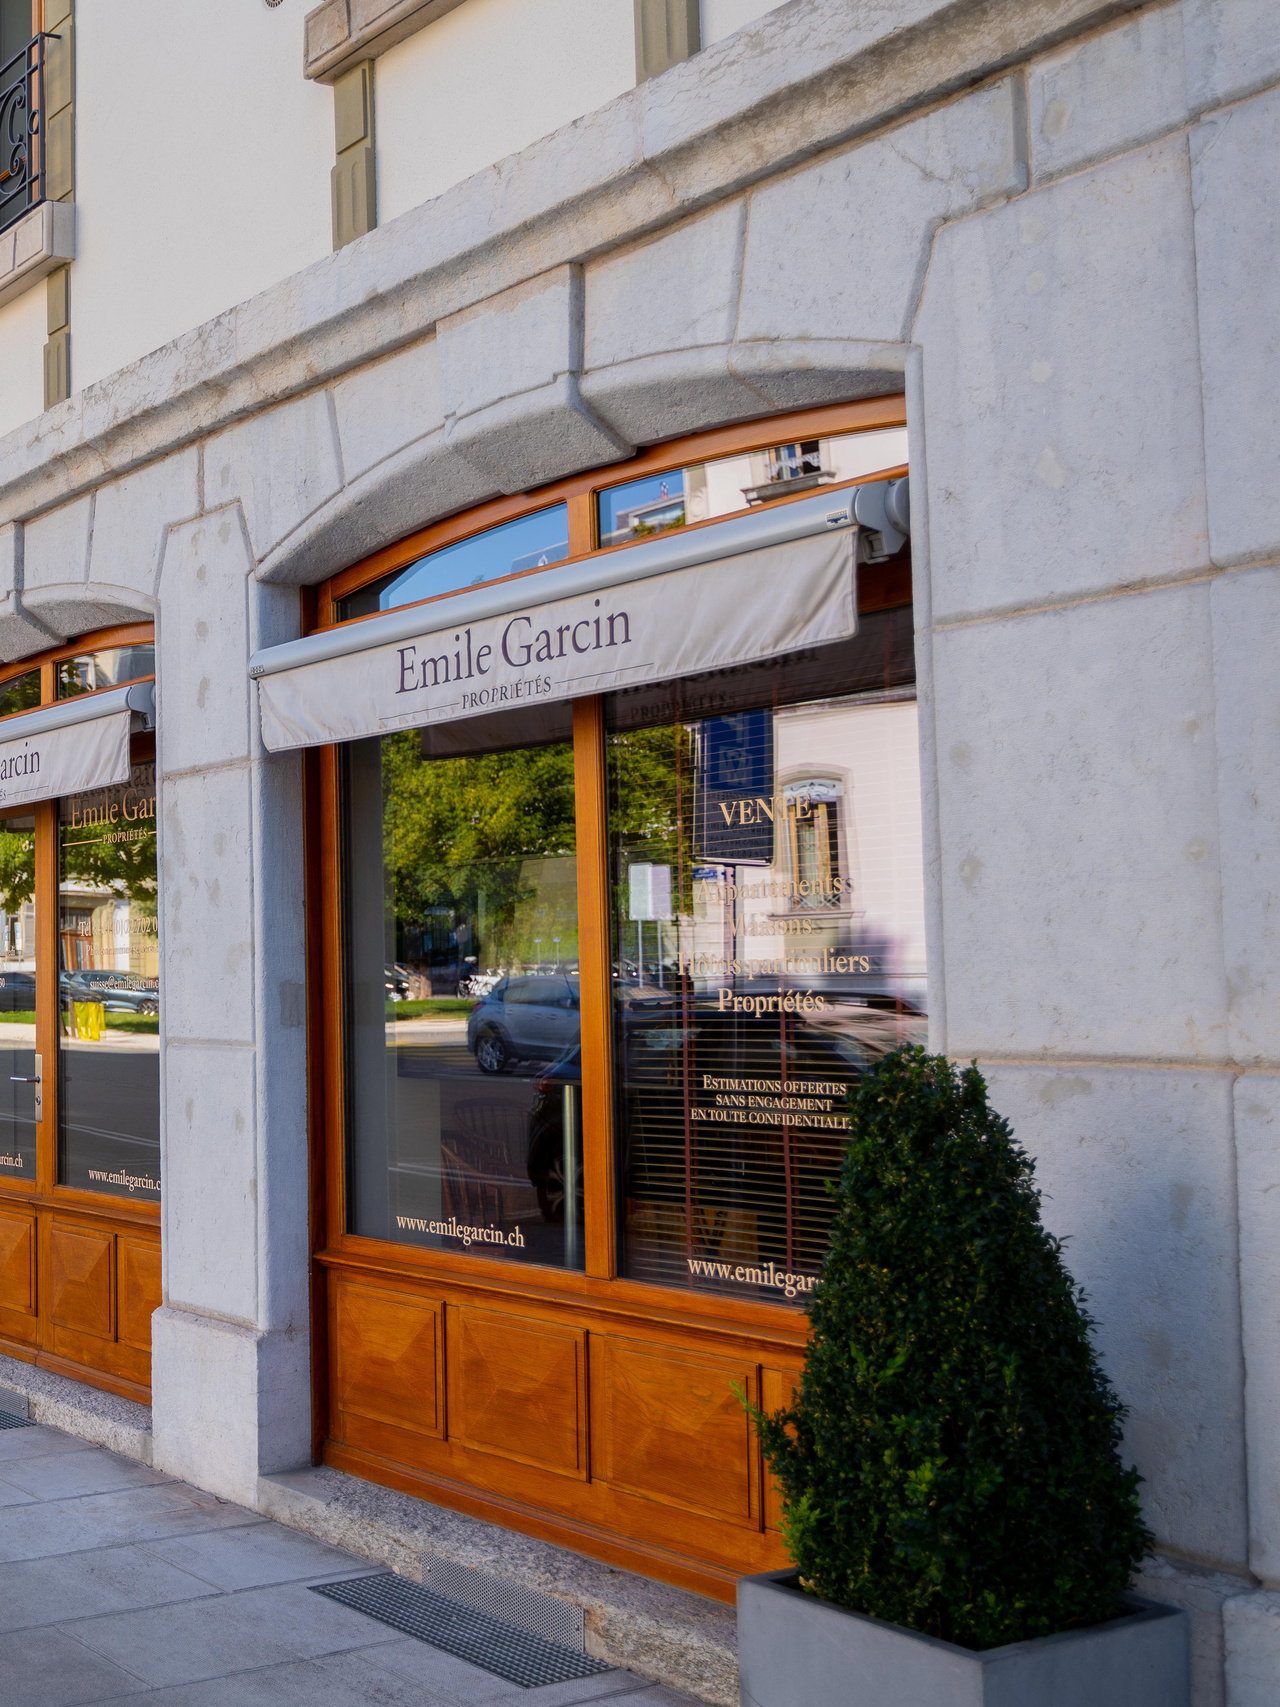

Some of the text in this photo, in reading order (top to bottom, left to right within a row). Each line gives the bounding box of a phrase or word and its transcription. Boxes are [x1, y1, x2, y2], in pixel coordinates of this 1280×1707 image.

[395, 598, 633, 695] Emile Garcin
[461, 674, 553, 711] PROPRIÉTÉS
[70, 788, 156, 830] Emile Gar
[719, 795, 812, 826] VENTE
[103, 827, 148, 845] PROPRIÉTÉS
[697, 875, 844, 906] Appartements
[726, 911, 813, 937] Maisons
[678, 947, 870, 980] Hôtels particuliers
[89, 975, 159, 992] suisse@emilegarcin.c
[717, 987, 825, 1018] Propriétés
[703, 1074, 847, 1096] ESTIMATIONS OFFERTES
[715, 1093, 833, 1112] SANS ENGAGEMENT
[691, 1108, 853, 1130] EN TOUTE CONFIDENTIALI
[88, 1168, 160, 1191] www.emilegarcin.c
[396, 1215, 525, 1248] www.emilegarcin.ch
[686, 1258, 824, 1297] www.emilegar
